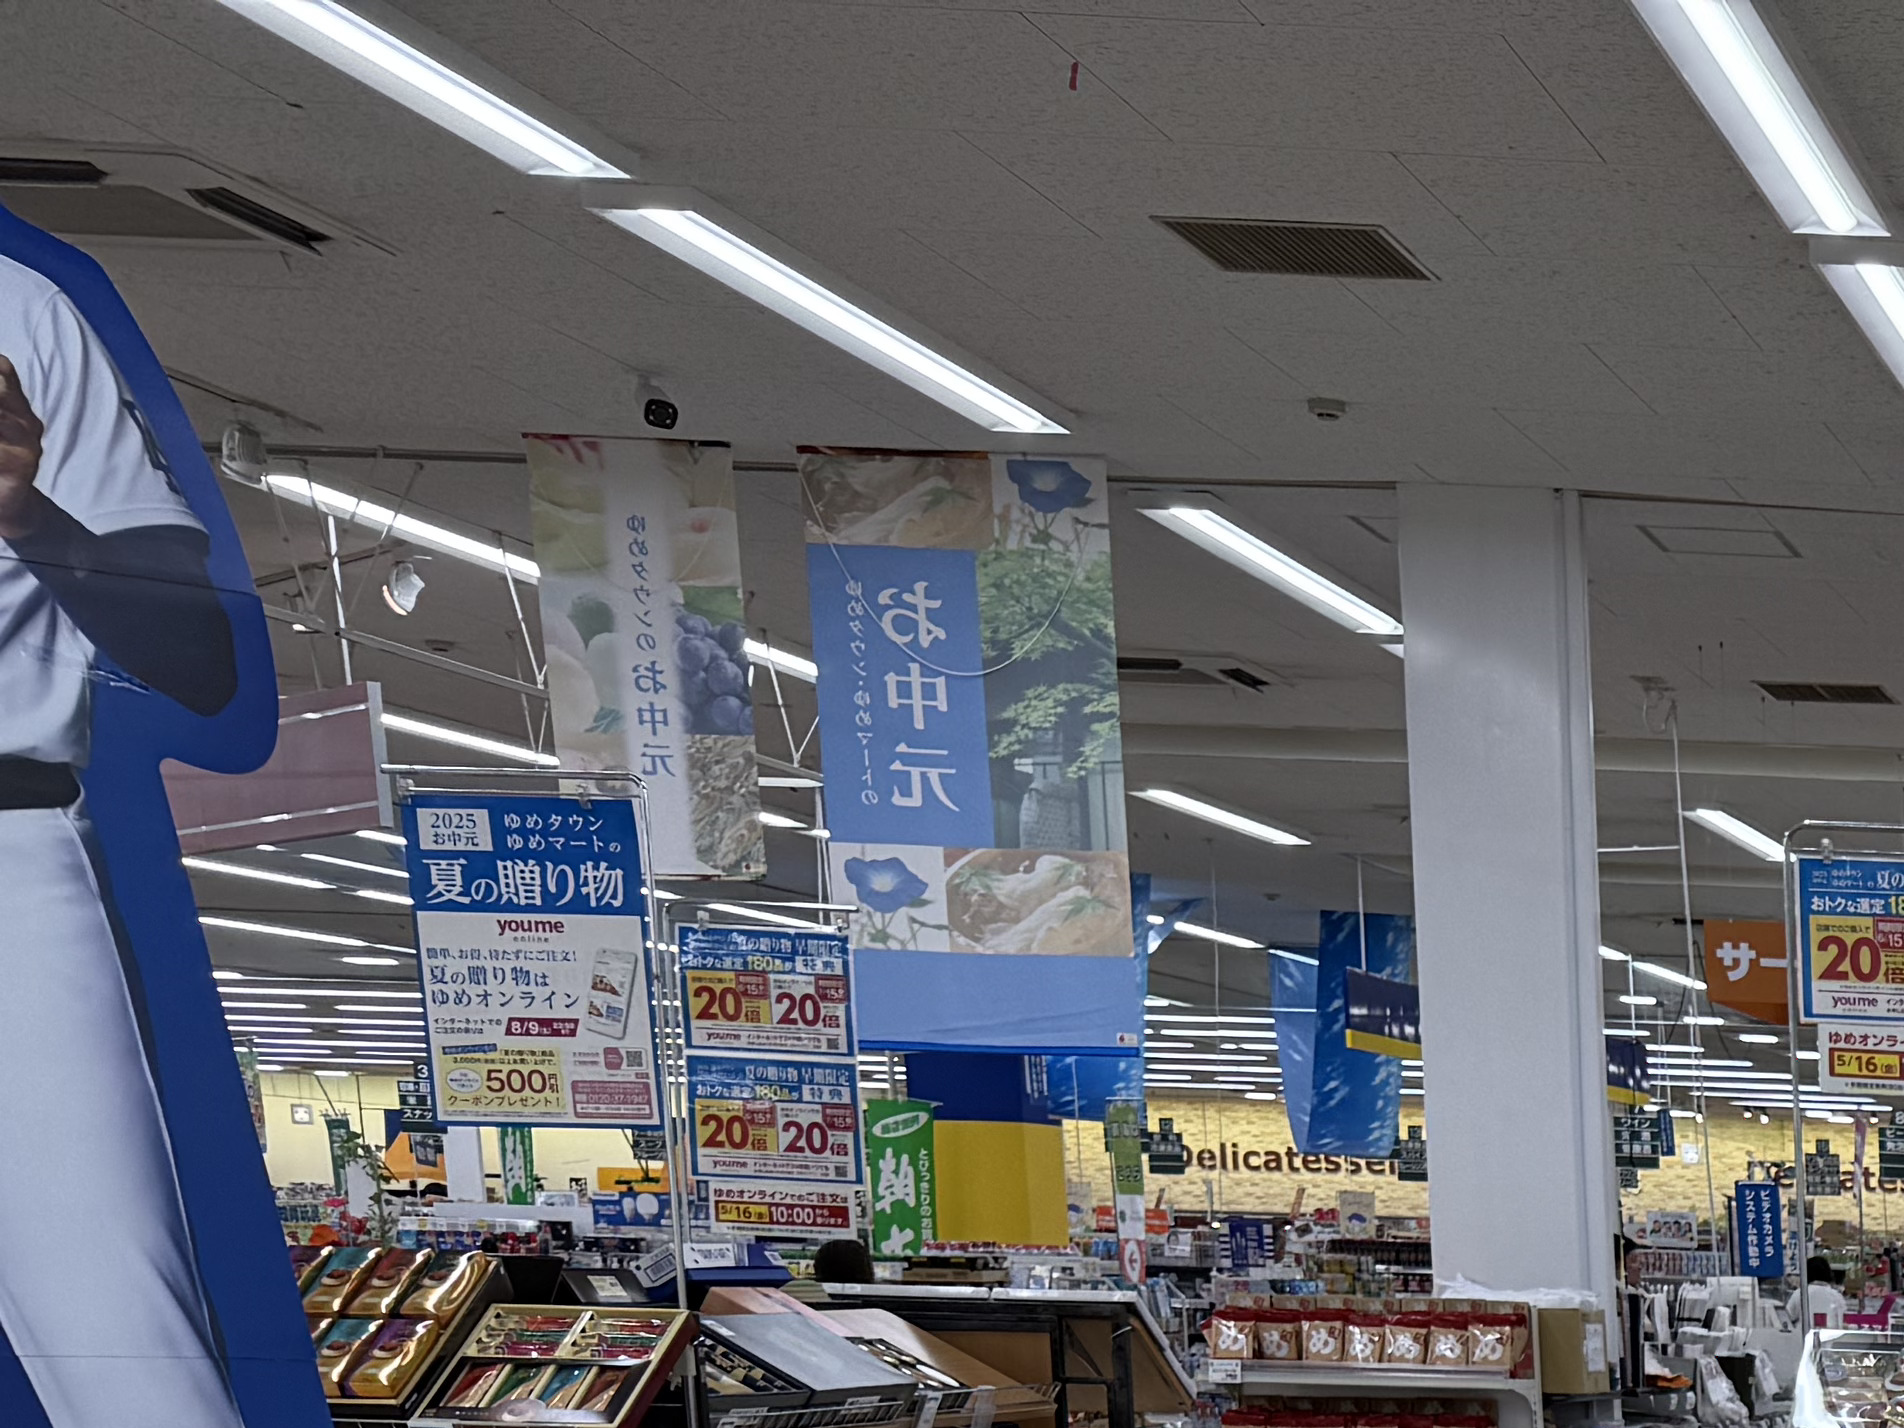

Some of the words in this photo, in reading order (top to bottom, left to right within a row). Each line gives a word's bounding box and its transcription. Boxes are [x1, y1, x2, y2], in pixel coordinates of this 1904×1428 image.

[430, 812, 477, 829] 2025
[504, 813, 603, 832] ゆめタウン
[431, 831, 480, 847] お中元
[506, 833, 621, 853] ゆめマートの
[422, 857, 624, 908] 夏の贈り物
[429, 965, 549, 987] 夏の贈り物は
[431, 989, 580, 1009] ゆめオンライン
[1621, 1118, 1650, 1127] ワイン
[770, 1206, 813, 1223] 10:00
[1760, 1189, 1775, 1257] ビデオカメラ
[1744, 1189, 1760, 1268] システム作動中
